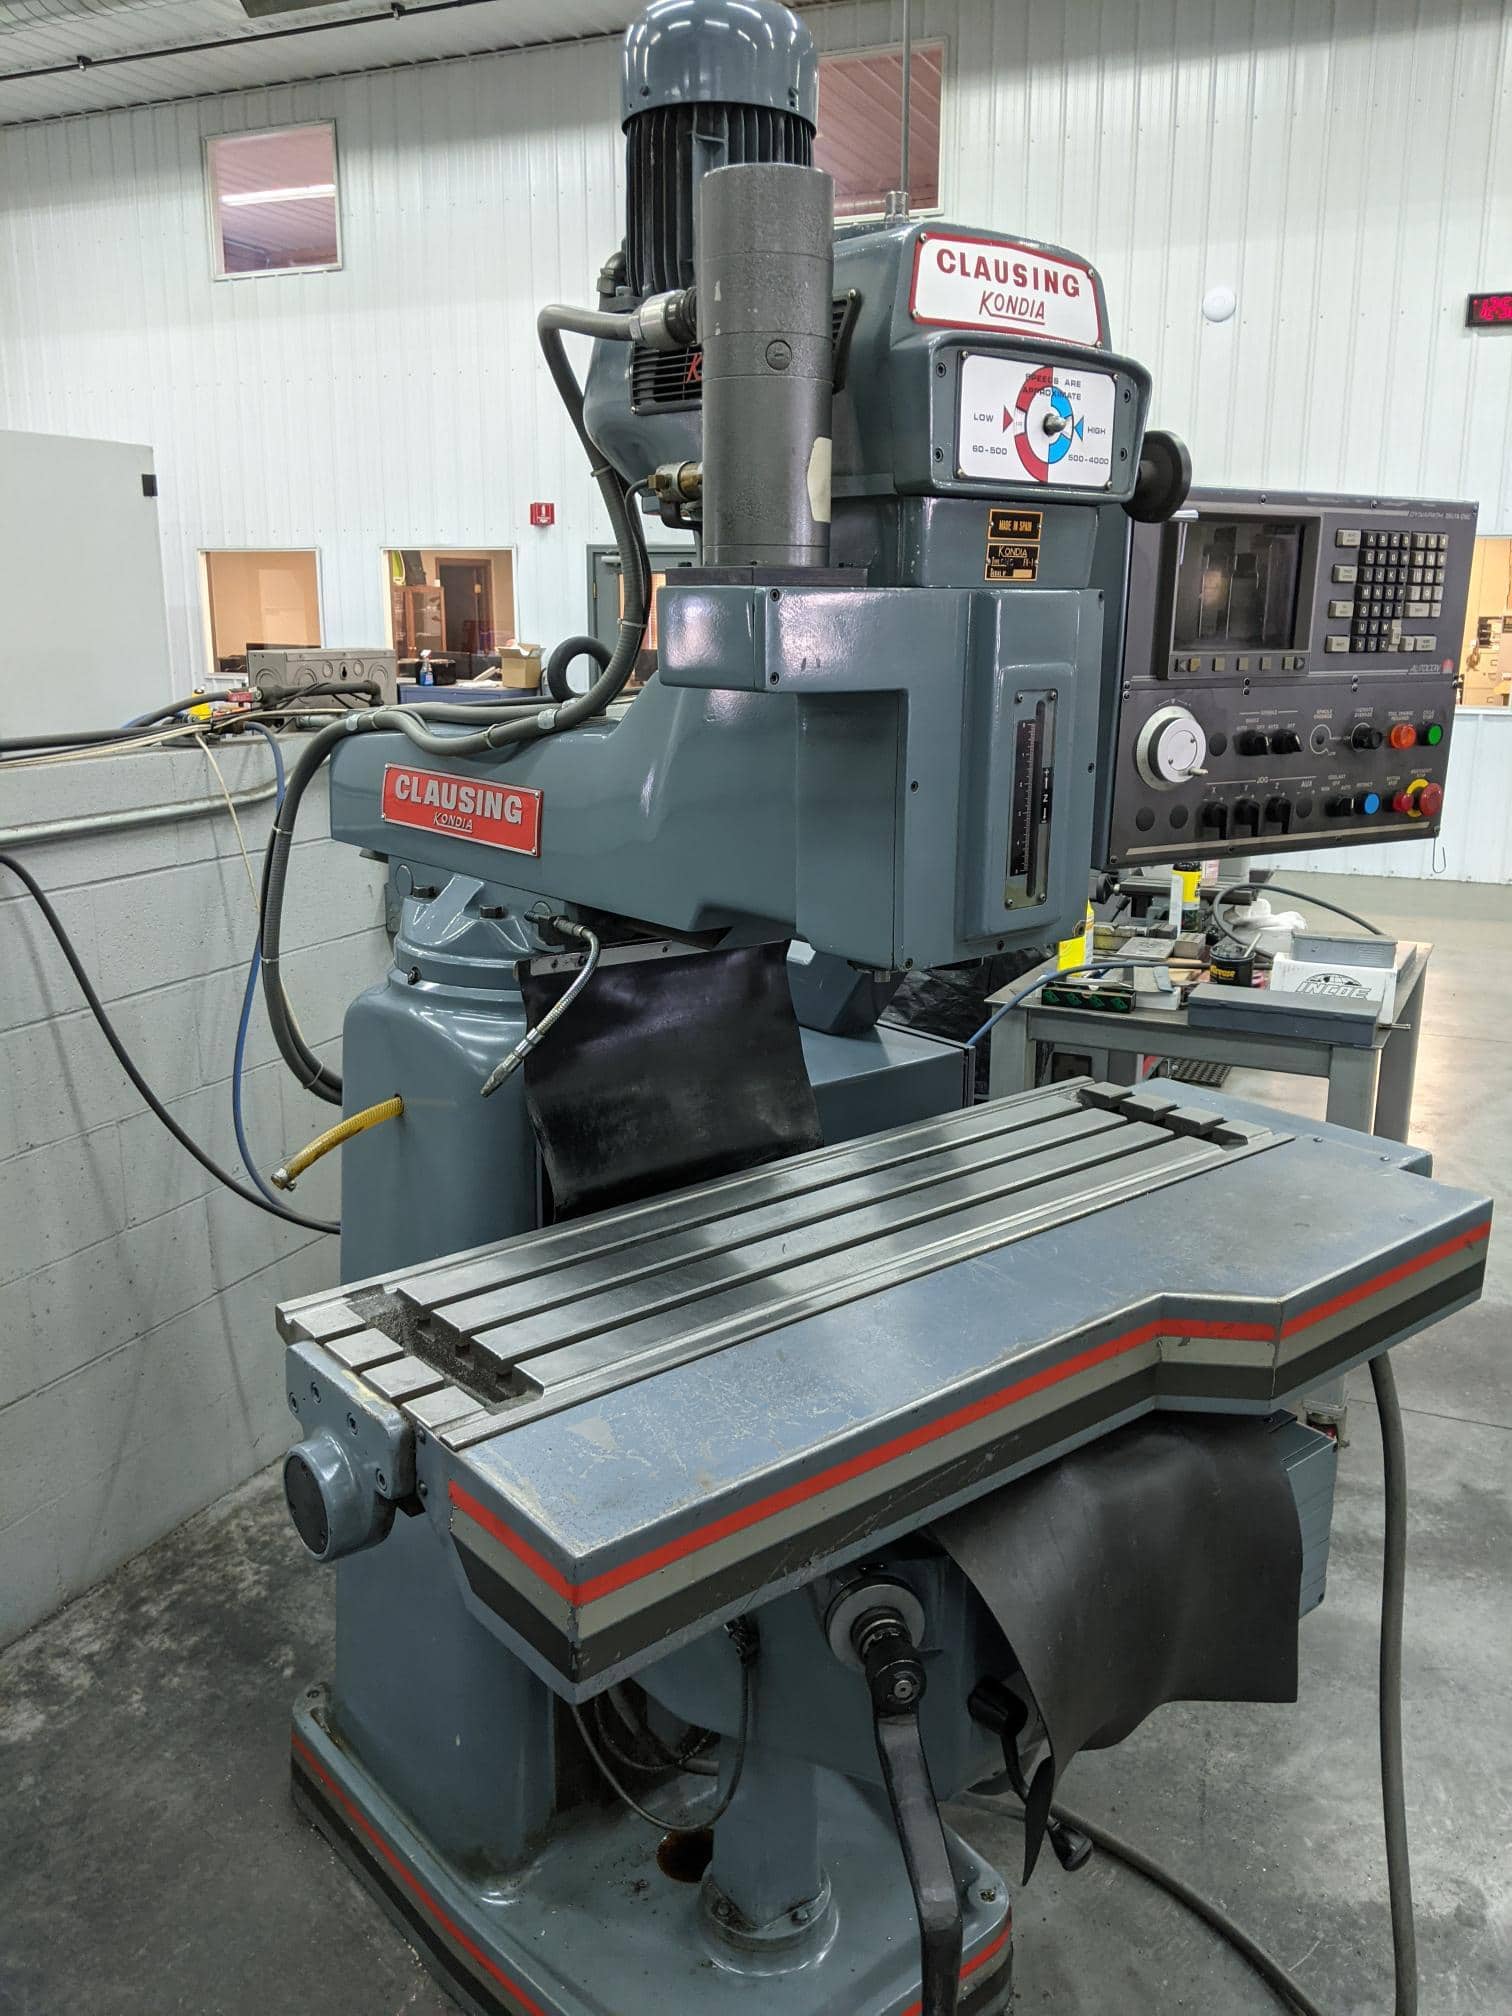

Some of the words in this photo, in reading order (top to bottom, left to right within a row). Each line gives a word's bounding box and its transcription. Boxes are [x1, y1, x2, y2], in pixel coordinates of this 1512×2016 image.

[936, 248, 1080, 298] CLAUSING
[978, 291, 1046, 324] KONDIA
[1025, 373, 1059, 385] SPEEDS
[1064, 379, 1082, 388] ARE
[1022, 386, 1082, 401] APPROXIMATE
[973, 413, 994, 423] LOW
[1087, 426, 1106, 435] HIGH
[972, 444, 1008, 456] 60-500
[1067, 454, 1109, 466] 500-4000
[999, 545, 1027, 558] KONDIA
[1301, 780, 1312, 788] AUX
[394, 773, 523, 825] CLAUSING
[433, 812, 473, 833] KONDIA
[1294, 980, 1372, 1000] INCOE
